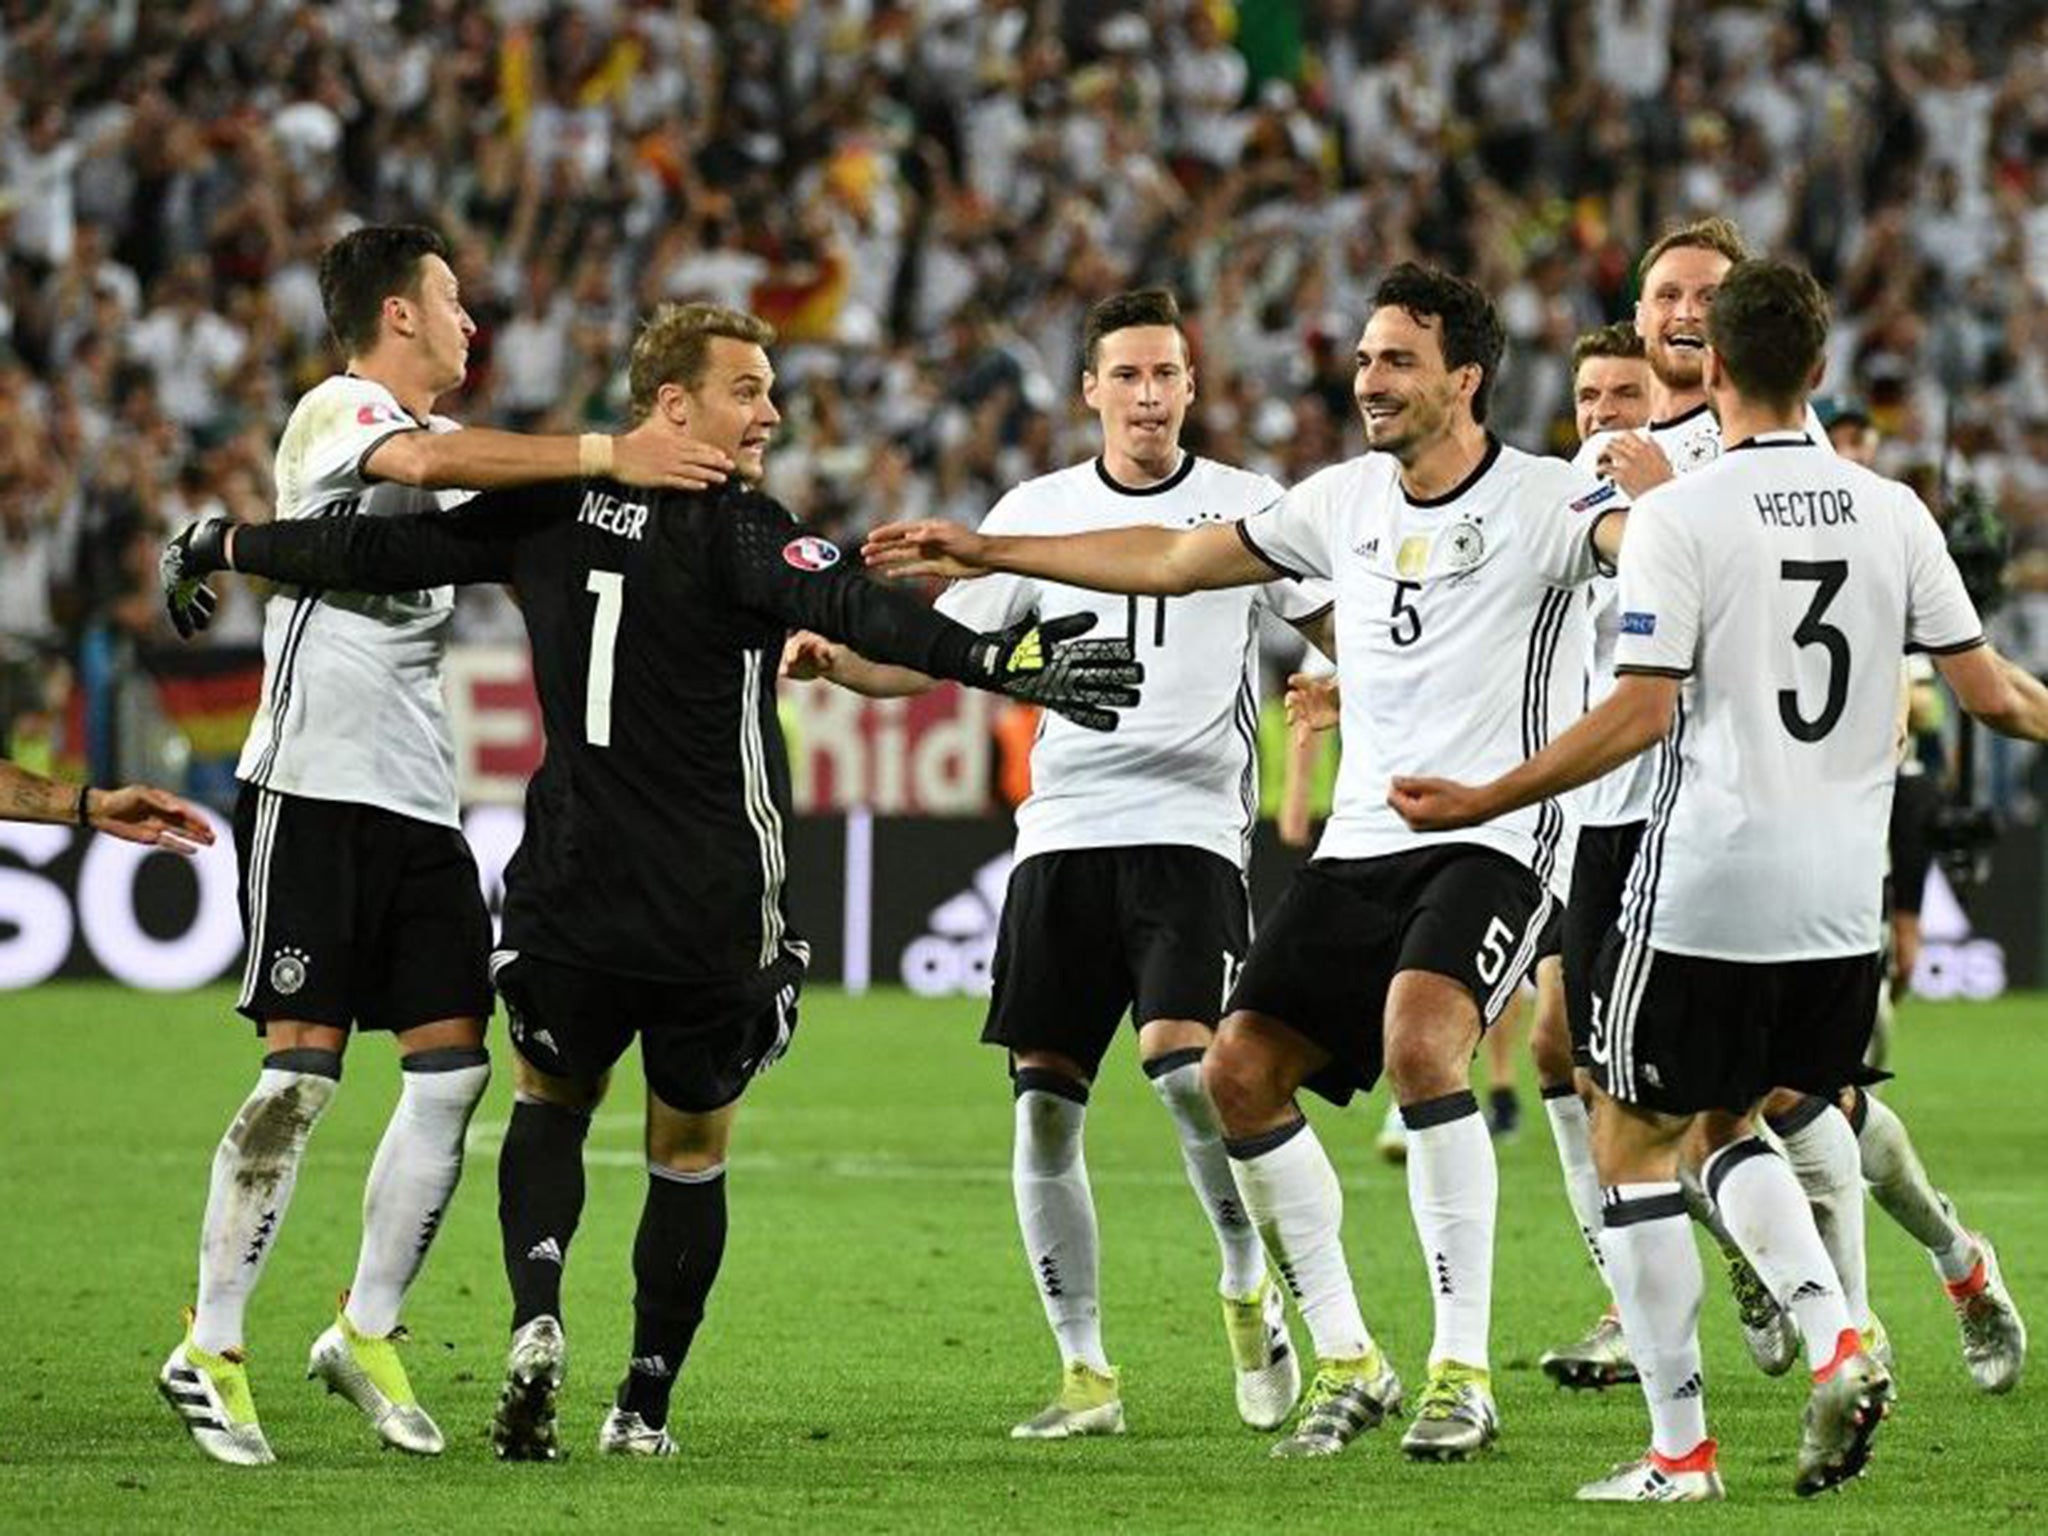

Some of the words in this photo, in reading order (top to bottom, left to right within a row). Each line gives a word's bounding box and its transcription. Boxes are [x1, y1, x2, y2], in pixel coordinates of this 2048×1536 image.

[1754, 489, 1858, 527] HECTOR
[1391, 579, 1423, 647] 5
[586, 568, 625, 748] 1
[1777, 559, 1852, 744] 3
[1476, 915, 1515, 986] 5
